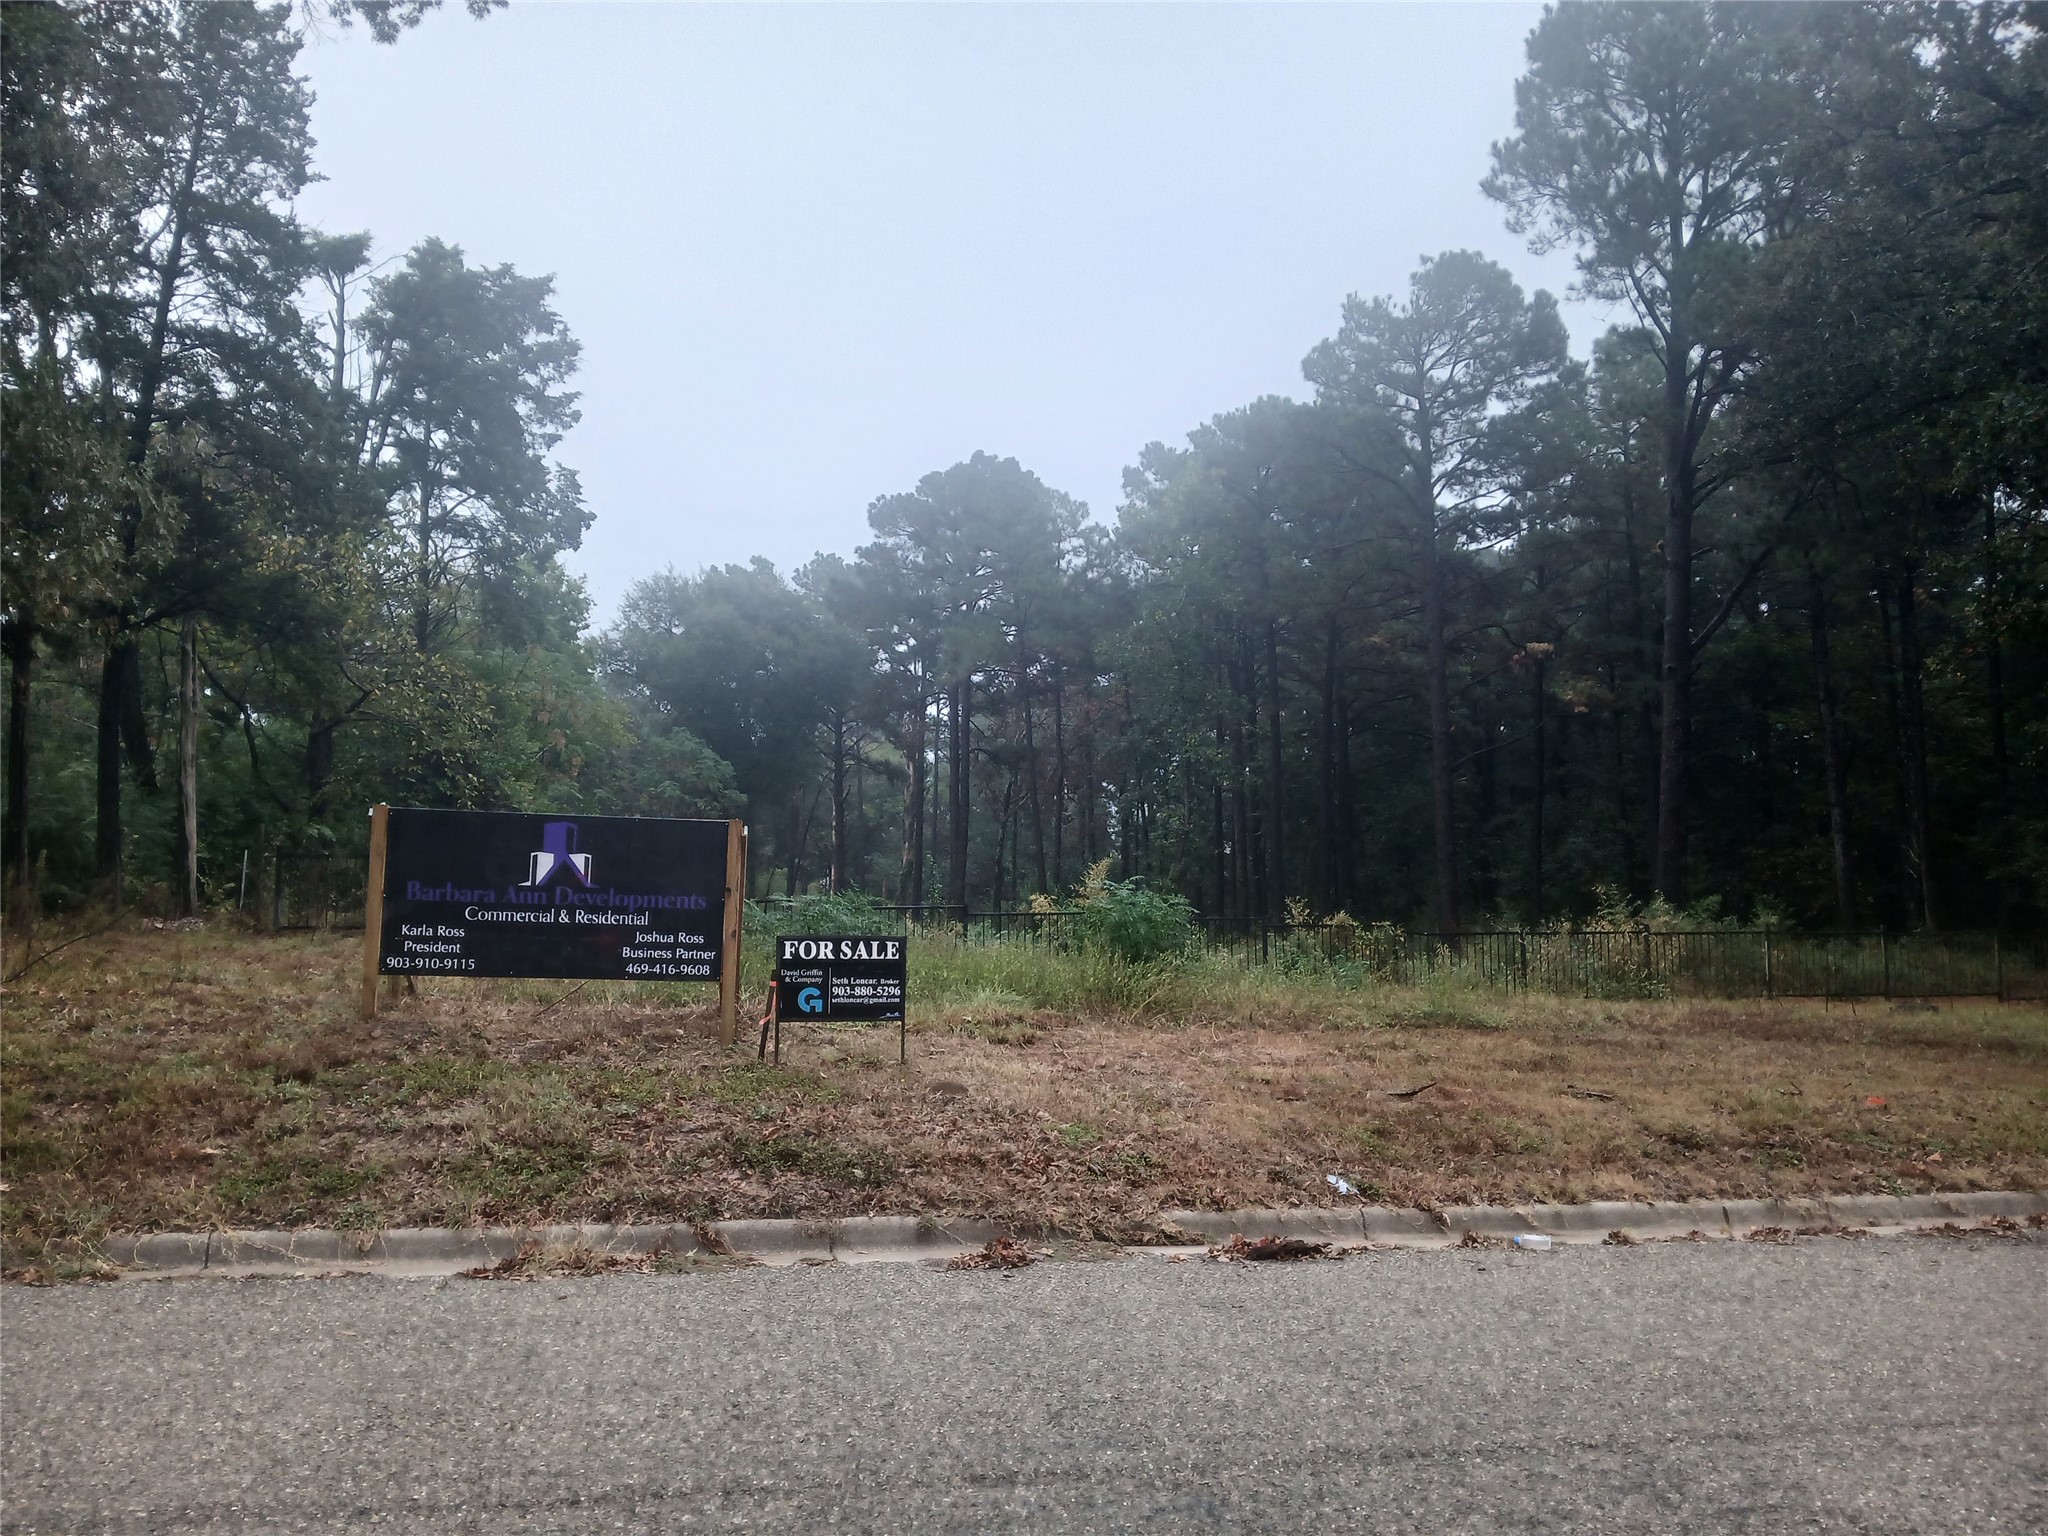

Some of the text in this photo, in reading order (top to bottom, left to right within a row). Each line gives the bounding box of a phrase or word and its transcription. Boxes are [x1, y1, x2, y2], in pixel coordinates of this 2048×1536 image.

[406, 880, 707, 913] Barbara Ann Developments
[465, 906, 649, 926] Commercial & Residential
[401, 924, 465, 938] Karla Ross
[635, 931, 705, 944] Joshua Ross
[404, 940, 461, 954] President
[622, 947, 716, 960] Business Partner
[782, 940, 900, 960] FOR SALE
[386, 956, 475, 970] 903-910-9115
[625, 963, 711, 976] 469-416-9608
[792, 976, 823, 984] Company
[832, 977, 849, 985] Seth
[832, 986, 901, 996] 903-880-5296
